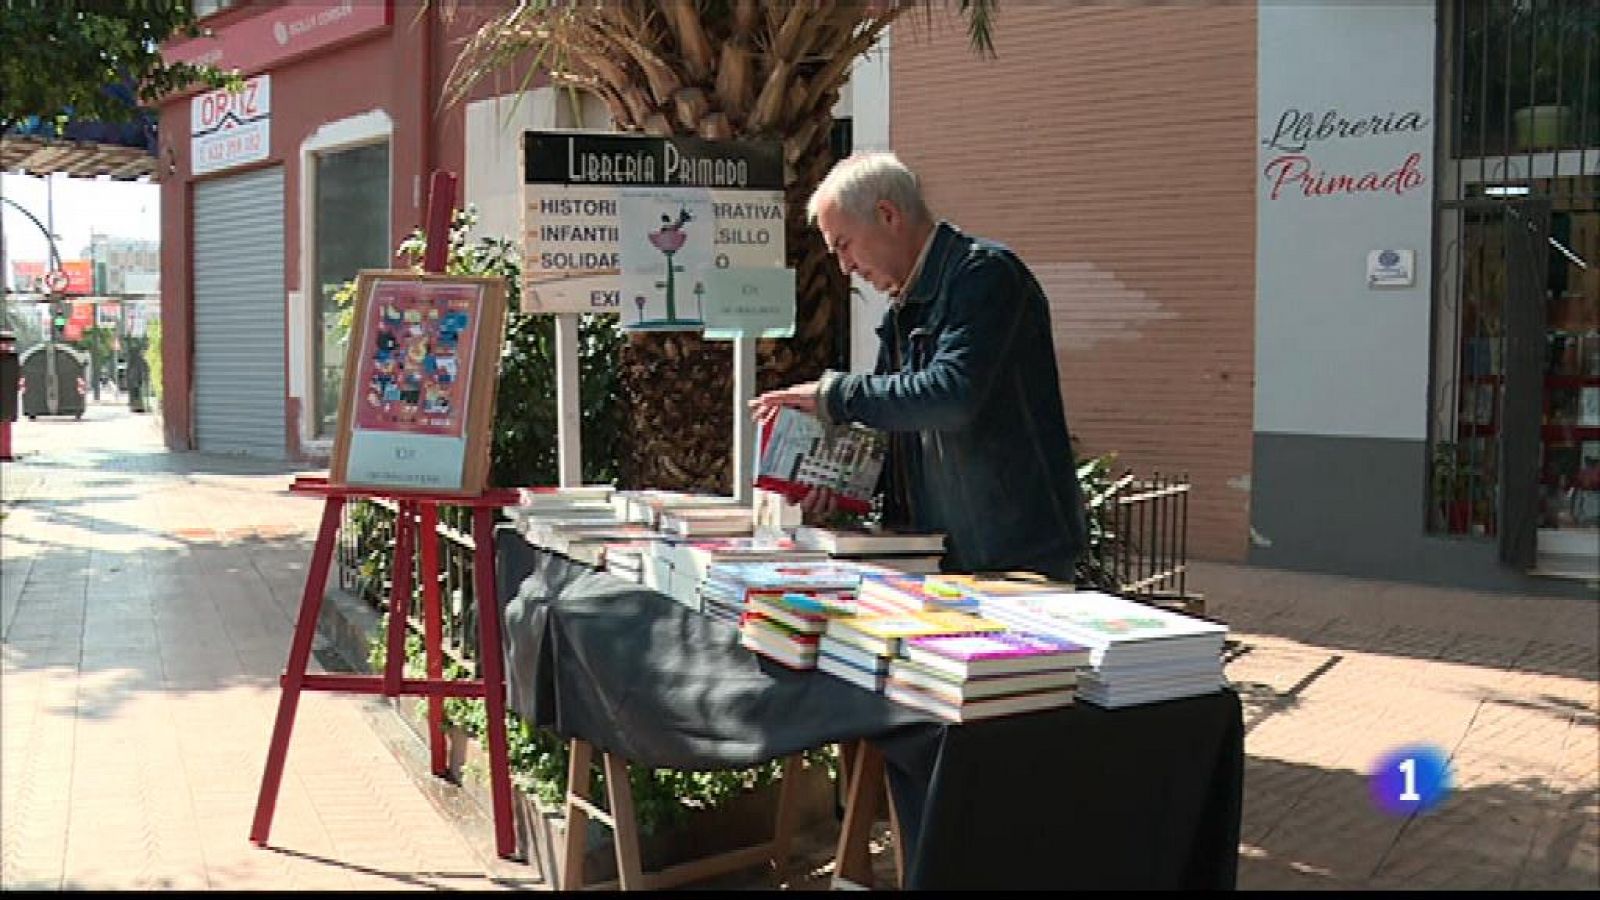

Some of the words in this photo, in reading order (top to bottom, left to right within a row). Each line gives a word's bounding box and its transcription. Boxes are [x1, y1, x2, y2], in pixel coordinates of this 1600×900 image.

[1263, 152, 1426, 201] Primado
[541, 199, 617, 216] HISTORI
[714, 227, 770, 245] SILLO
[715, 252, 730, 270] O
